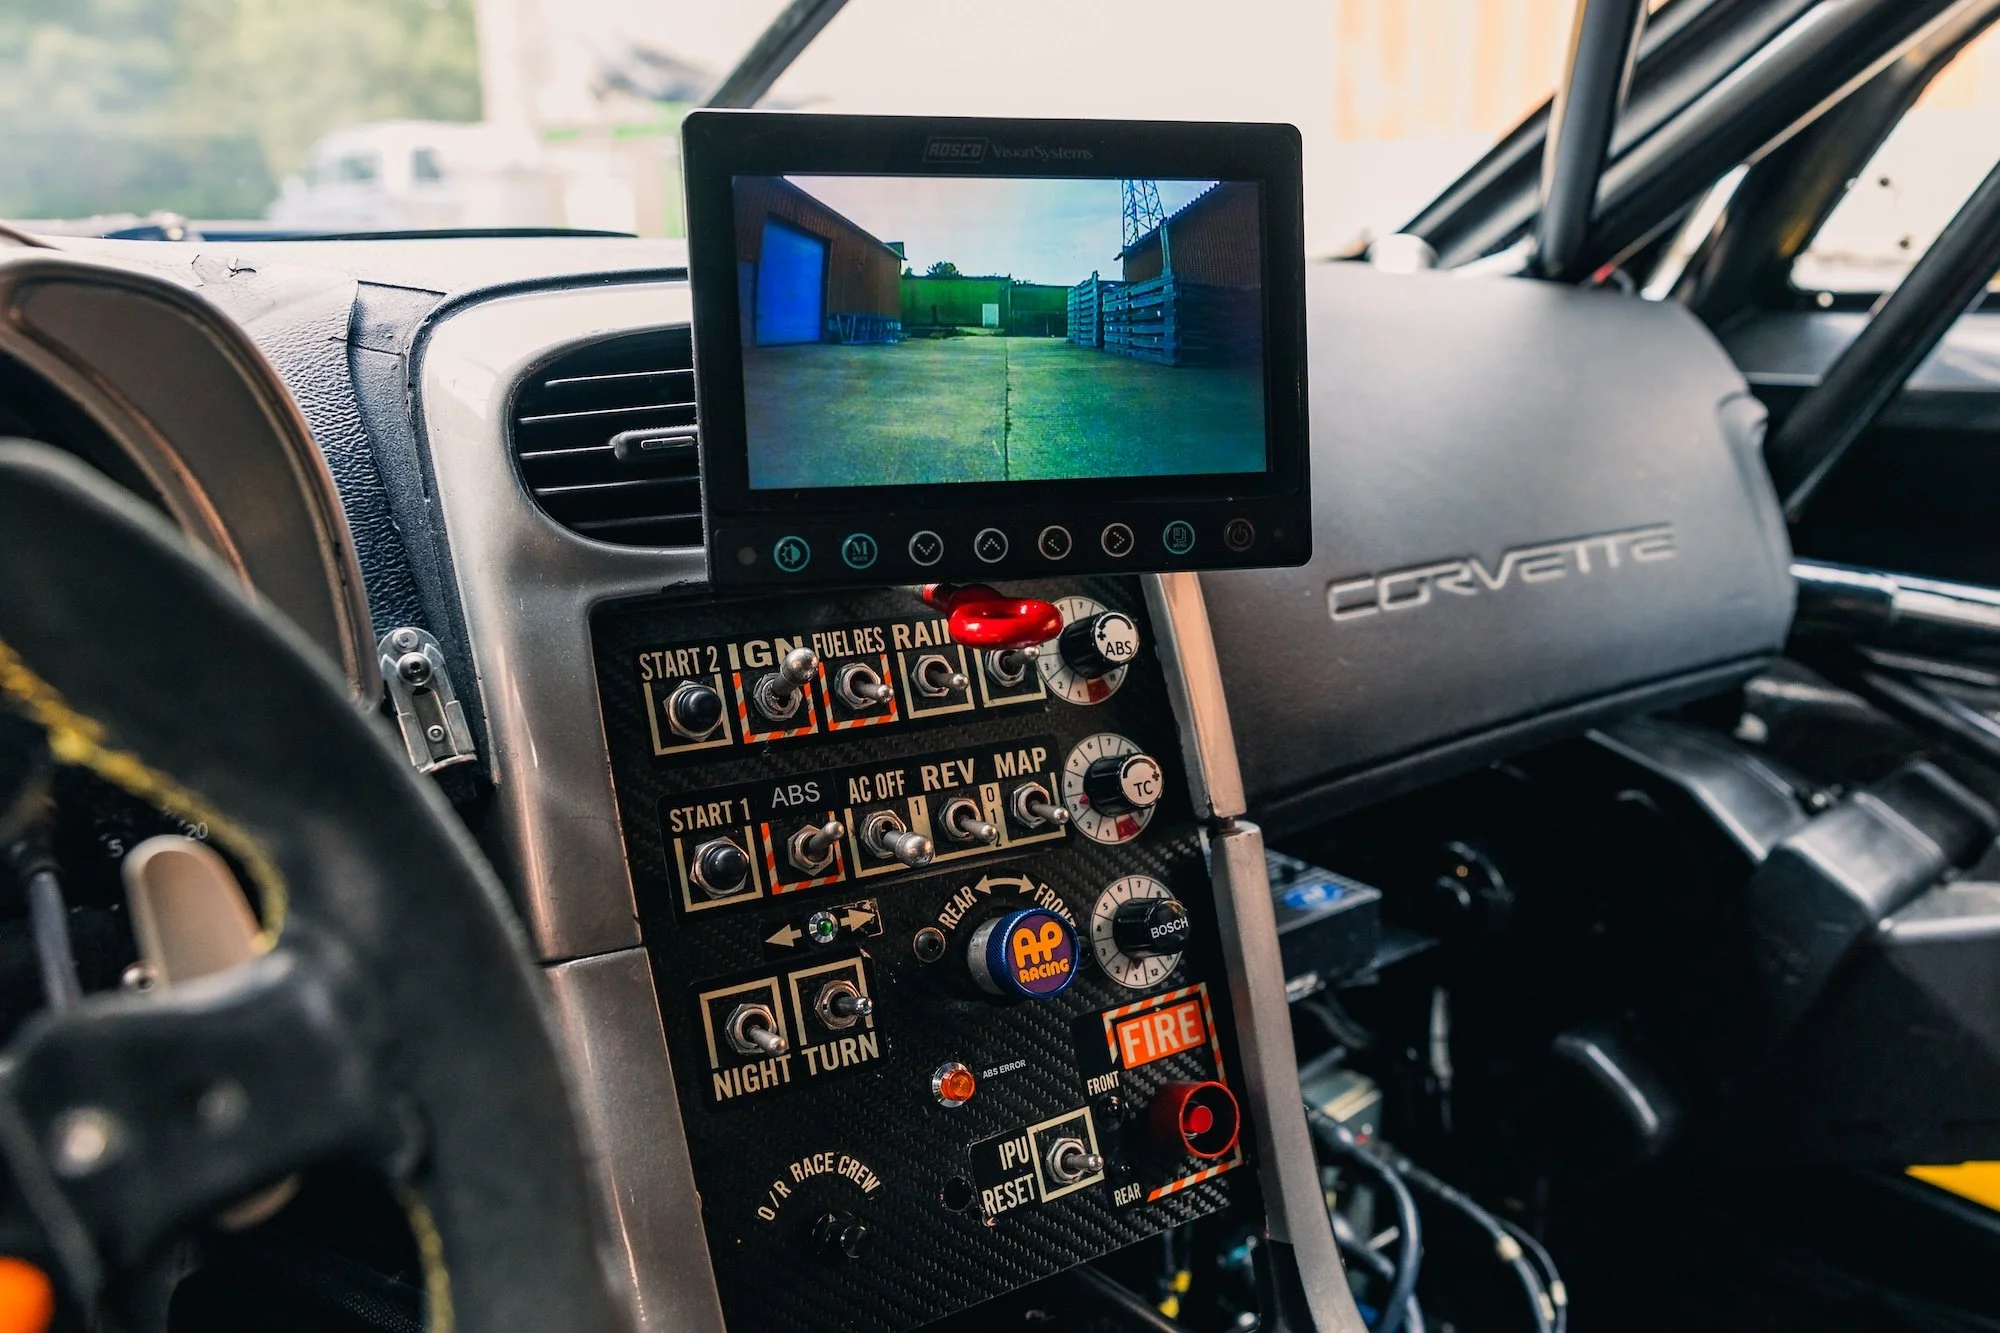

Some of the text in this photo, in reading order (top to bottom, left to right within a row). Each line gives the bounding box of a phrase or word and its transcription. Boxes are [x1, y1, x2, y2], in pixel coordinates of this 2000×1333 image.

[1327, 522, 1679, 621] CORVETTE
[1105, 641, 1133, 656] ABS
[639, 645, 721, 681] START 2
[1087, 742, 1093, 750] 6
[920, 758, 975, 792] REV
[993, 746, 1047, 779] MAP
[771, 781, 821, 809] ABS
[848, 769, 905, 805] AC OFF
[986, 787, 995, 802] 0
[1133, 780, 1154, 797] TC
[669, 797, 750, 833] START 1
[914, 800, 921, 816] 1
[990, 808, 997, 824] 1
[1073, 803, 1078, 811] 3
[1086, 821, 1092, 829] 2
[108, 838, 124, 858] 5
[1117, 884, 1122, 892] 6
[938, 885, 978, 930] REAR
[1150, 917, 1189, 938] BOSCH
[1012, 921, 1064, 968] AP
[1101, 948, 1106, 956] 3
[1018, 958, 1070, 984] RACING
[1115, 966, 1120, 974] 2
[1121, 1004, 1201, 1064] FIRE
[712, 1031, 880, 1101] NIGHT TURN
[982, 1059, 1026, 1079] ABS ERROR
[1087, 1070, 1120, 1096] FRONT
[998, 1135, 1030, 1171] IPU
[789, 1151, 835, 1183] RACE
[837, 1155, 881, 1194] CREW
[982, 1173, 1036, 1215] RESET
[1114, 1182, 1142, 1207] REAR
